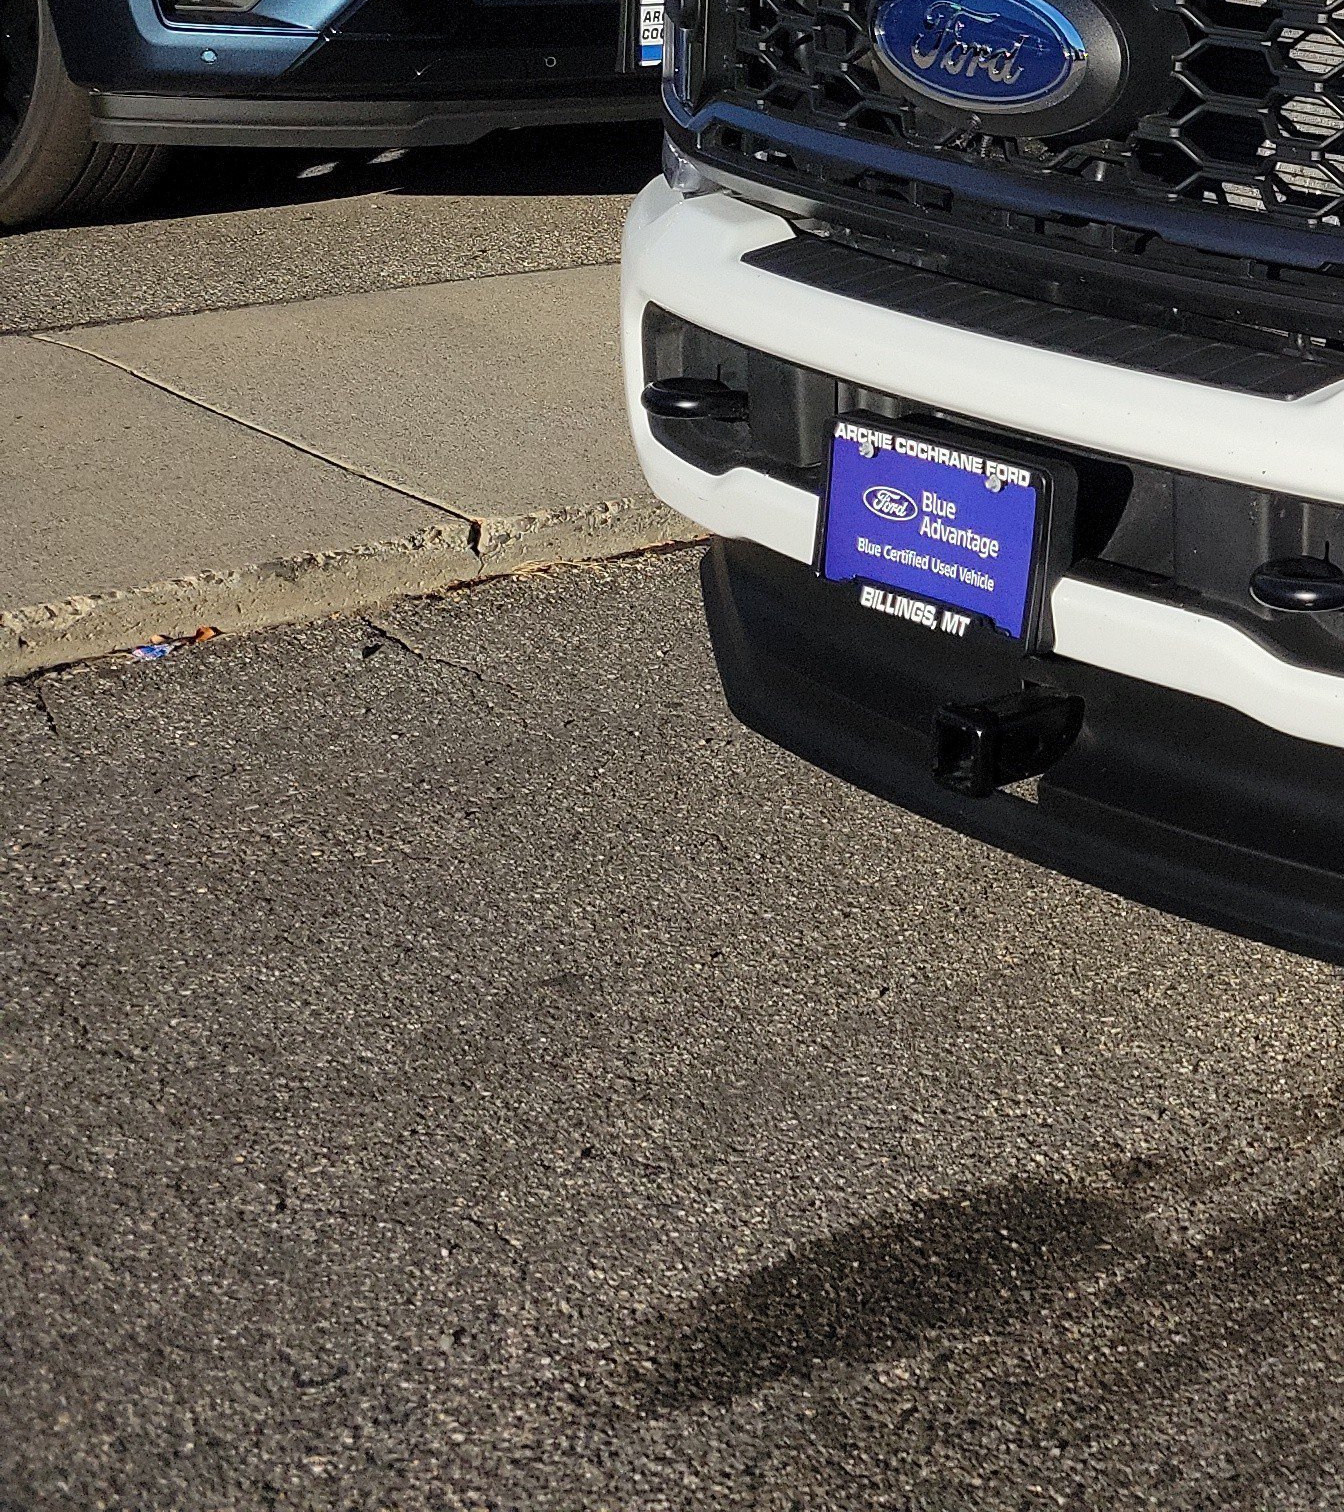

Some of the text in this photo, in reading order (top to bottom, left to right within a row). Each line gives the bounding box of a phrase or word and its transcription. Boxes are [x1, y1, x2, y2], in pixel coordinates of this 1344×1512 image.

[911, 0, 1032, 85] Ford
[834, 422, 1031, 488] ARCHIE COCHRANE FORD
[872, 490, 909, 516] Ford
[922, 490, 957, 519] Blue
[919, 516, 1000, 559] Advantage
[857, 537, 995, 592] Blue Certified Used Vehicle
[860, 585, 971, 638] BILLINGS, MT
